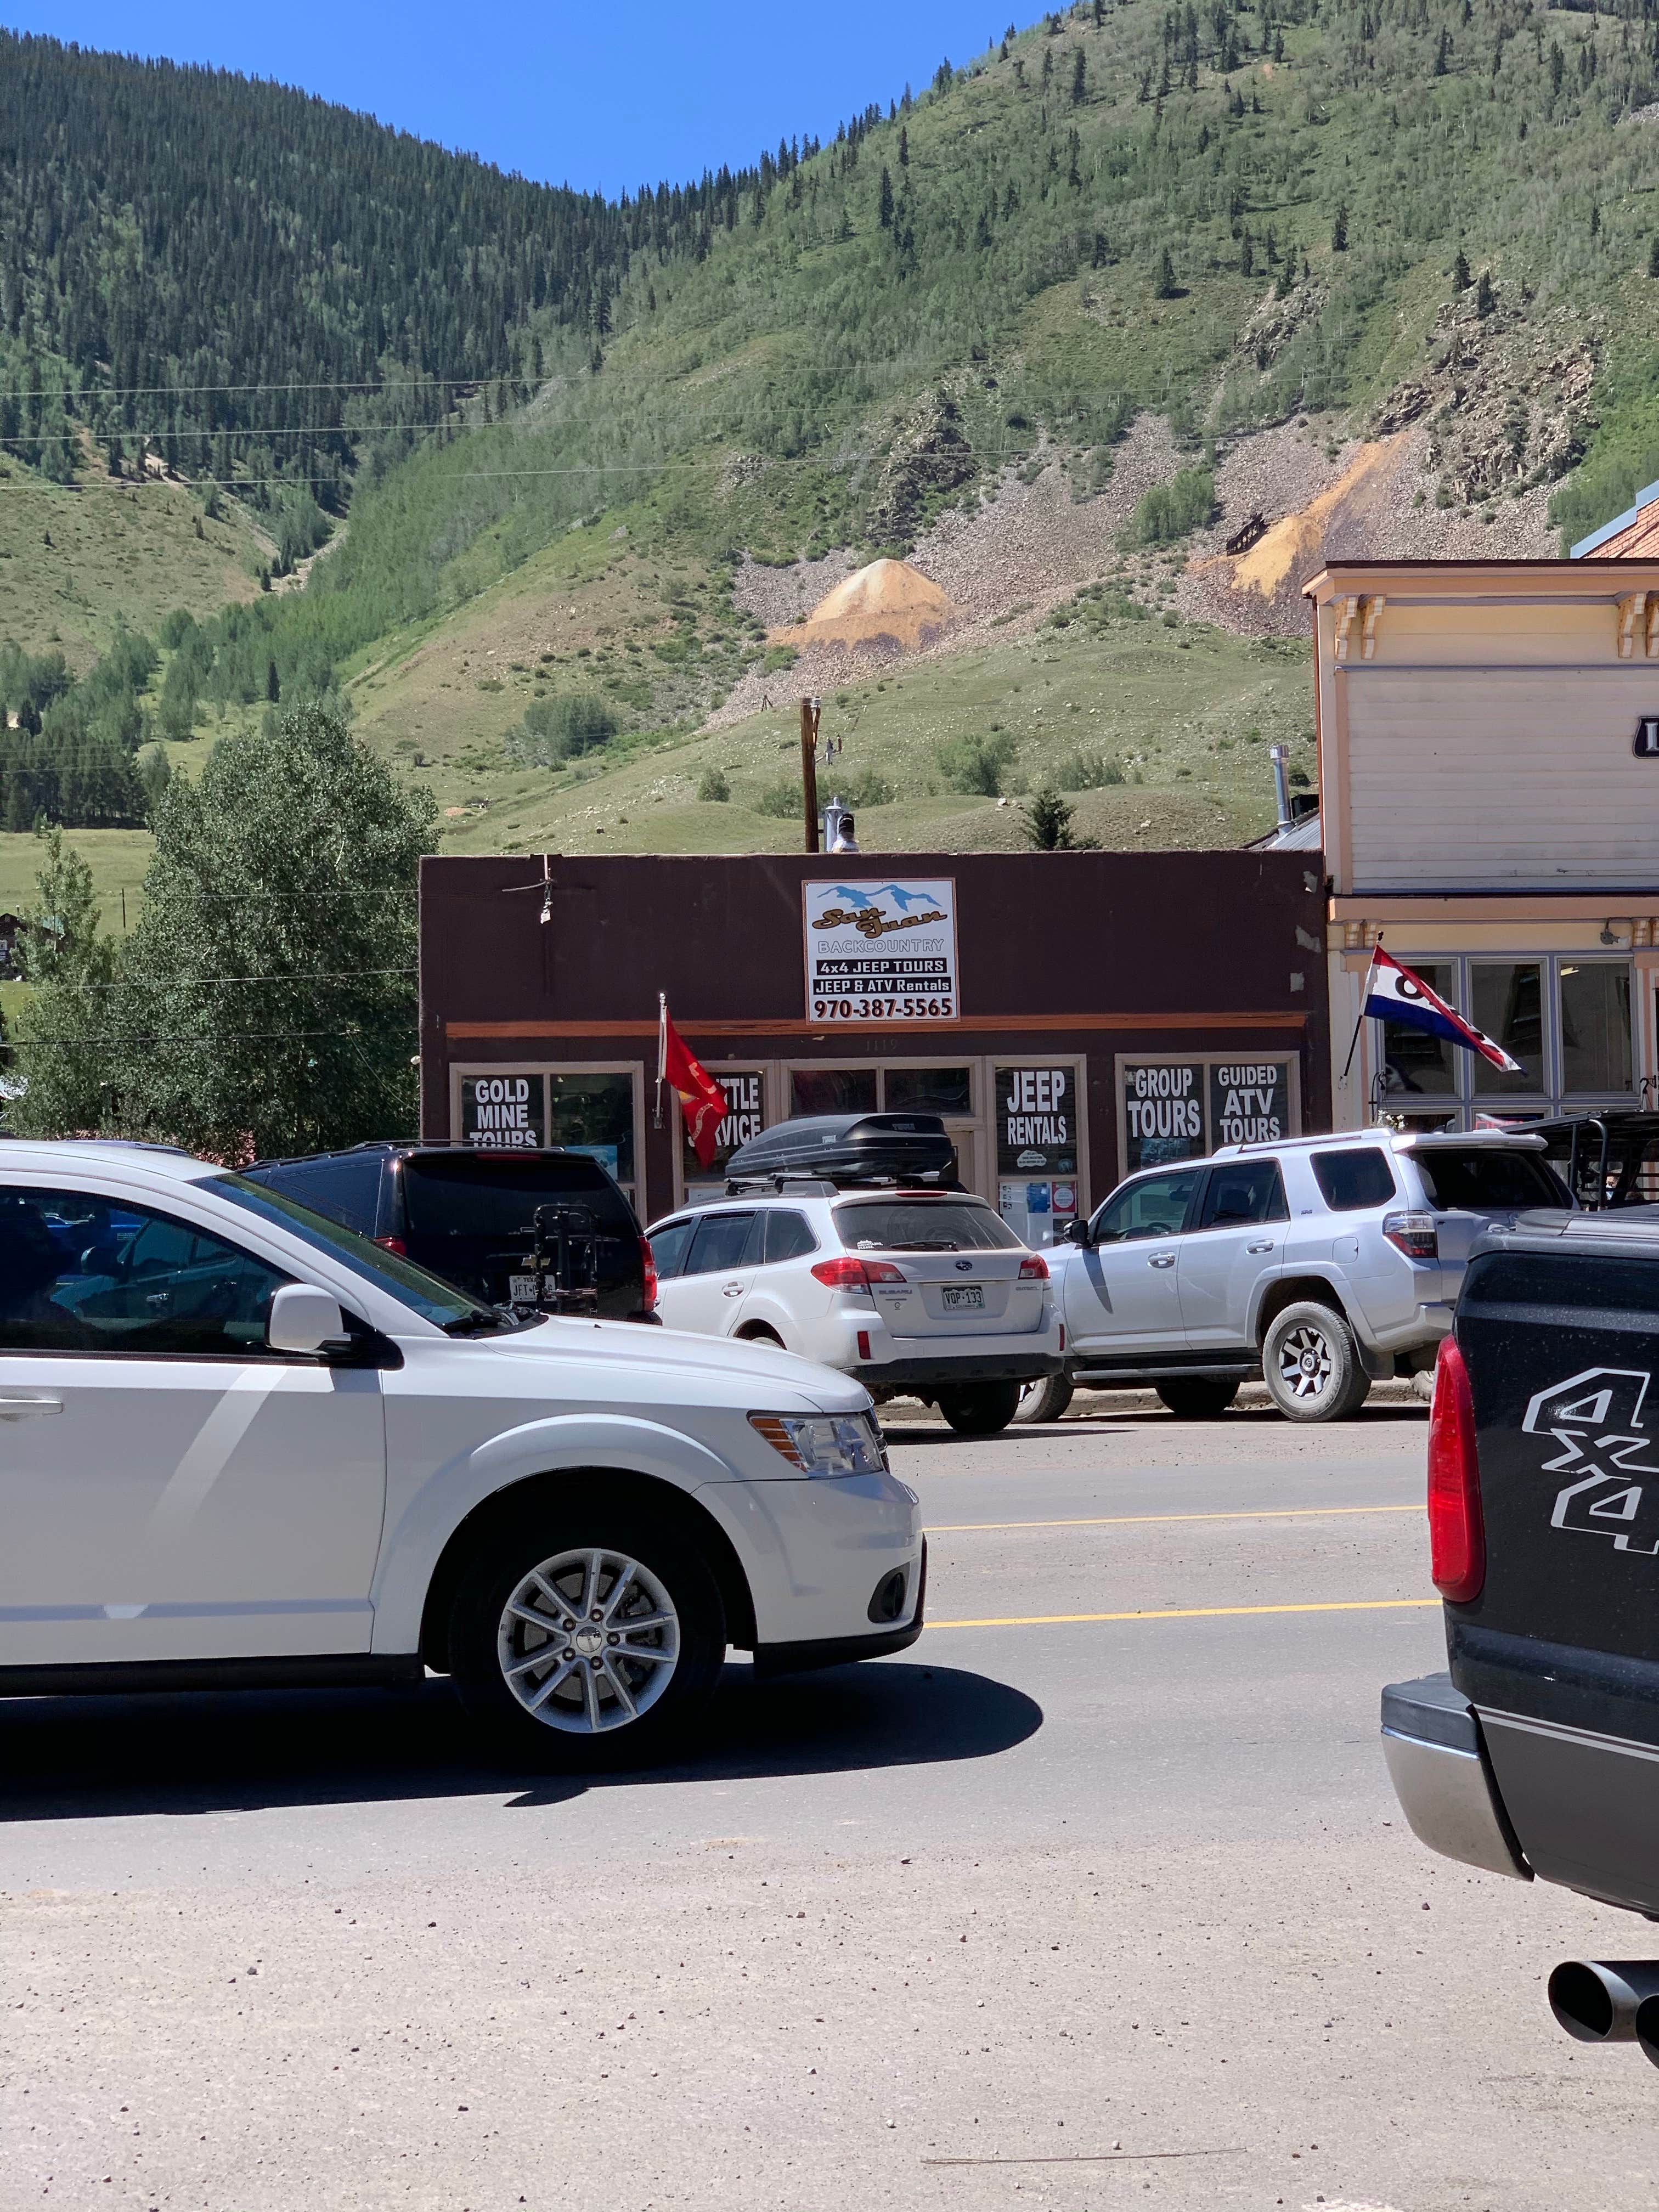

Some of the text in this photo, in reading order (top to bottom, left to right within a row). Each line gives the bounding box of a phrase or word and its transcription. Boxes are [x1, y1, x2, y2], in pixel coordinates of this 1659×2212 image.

[812, 907, 886, 929] San
[856, 911, 948, 939] Juan
[818, 939, 944, 953] BACKCOUNTRY
[820, 960, 944, 973] 4x4 JEEP TOURS
[816, 979, 950, 993] JEEP & ATV Rentals
[814, 997, 953, 1019] 970-387-5565
[1135, 1068, 1193, 1098] GROUP
[1218, 1065, 1277, 1086] GUIDED
[475, 1079, 529, 1103] GOLD
[716, 1078, 759, 1109] TTLE
[1007, 1070, 1065, 1113] JEEP
[1223, 1088, 1274, 1116] ATV
[477, 1104, 529, 1129] MINE
[1127, 1099, 1201, 1138] TOURS
[1220, 1116, 1280, 1143] TOURS
[1007, 1115, 1067, 1145] RENTALS
